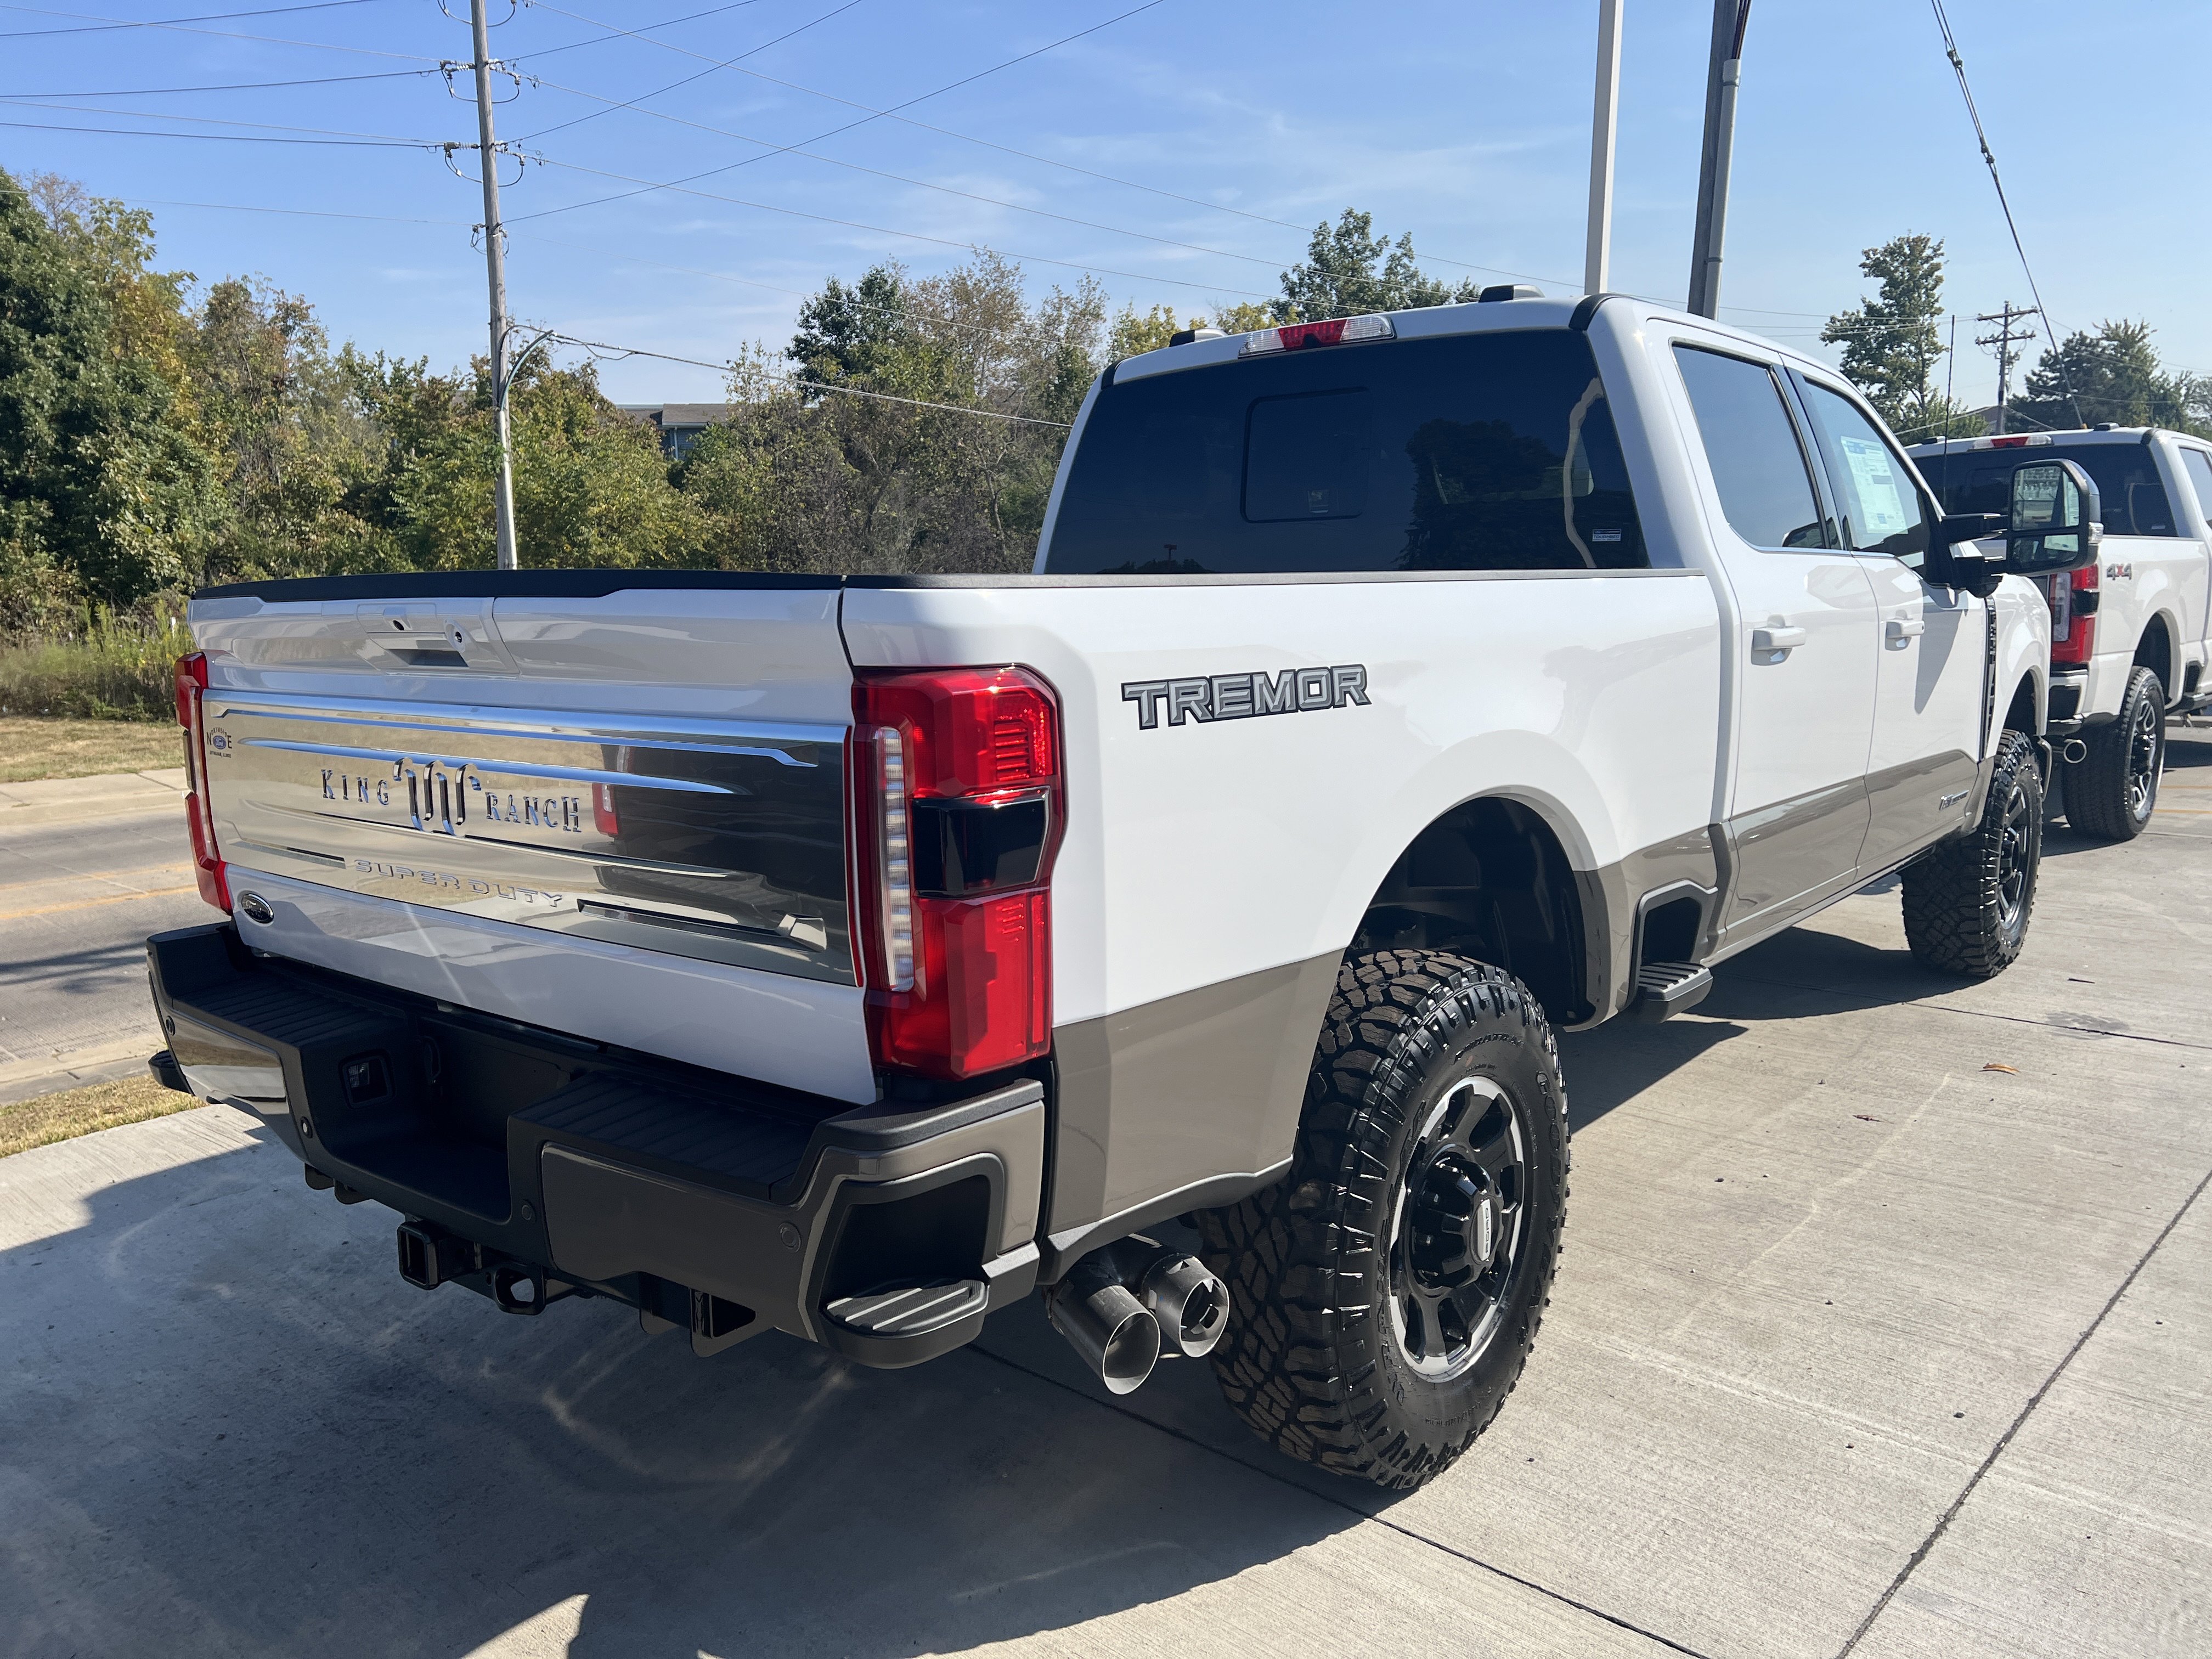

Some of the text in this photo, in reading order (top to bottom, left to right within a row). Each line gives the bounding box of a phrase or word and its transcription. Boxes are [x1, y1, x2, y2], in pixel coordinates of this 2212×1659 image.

[1121, 664, 1372, 730] TREMOR
[320, 769, 582, 832] KING RANCH
[354, 859, 563, 908] SUPER DUTY
[1517, 1071, 1561, 1347] GOODYEAR
